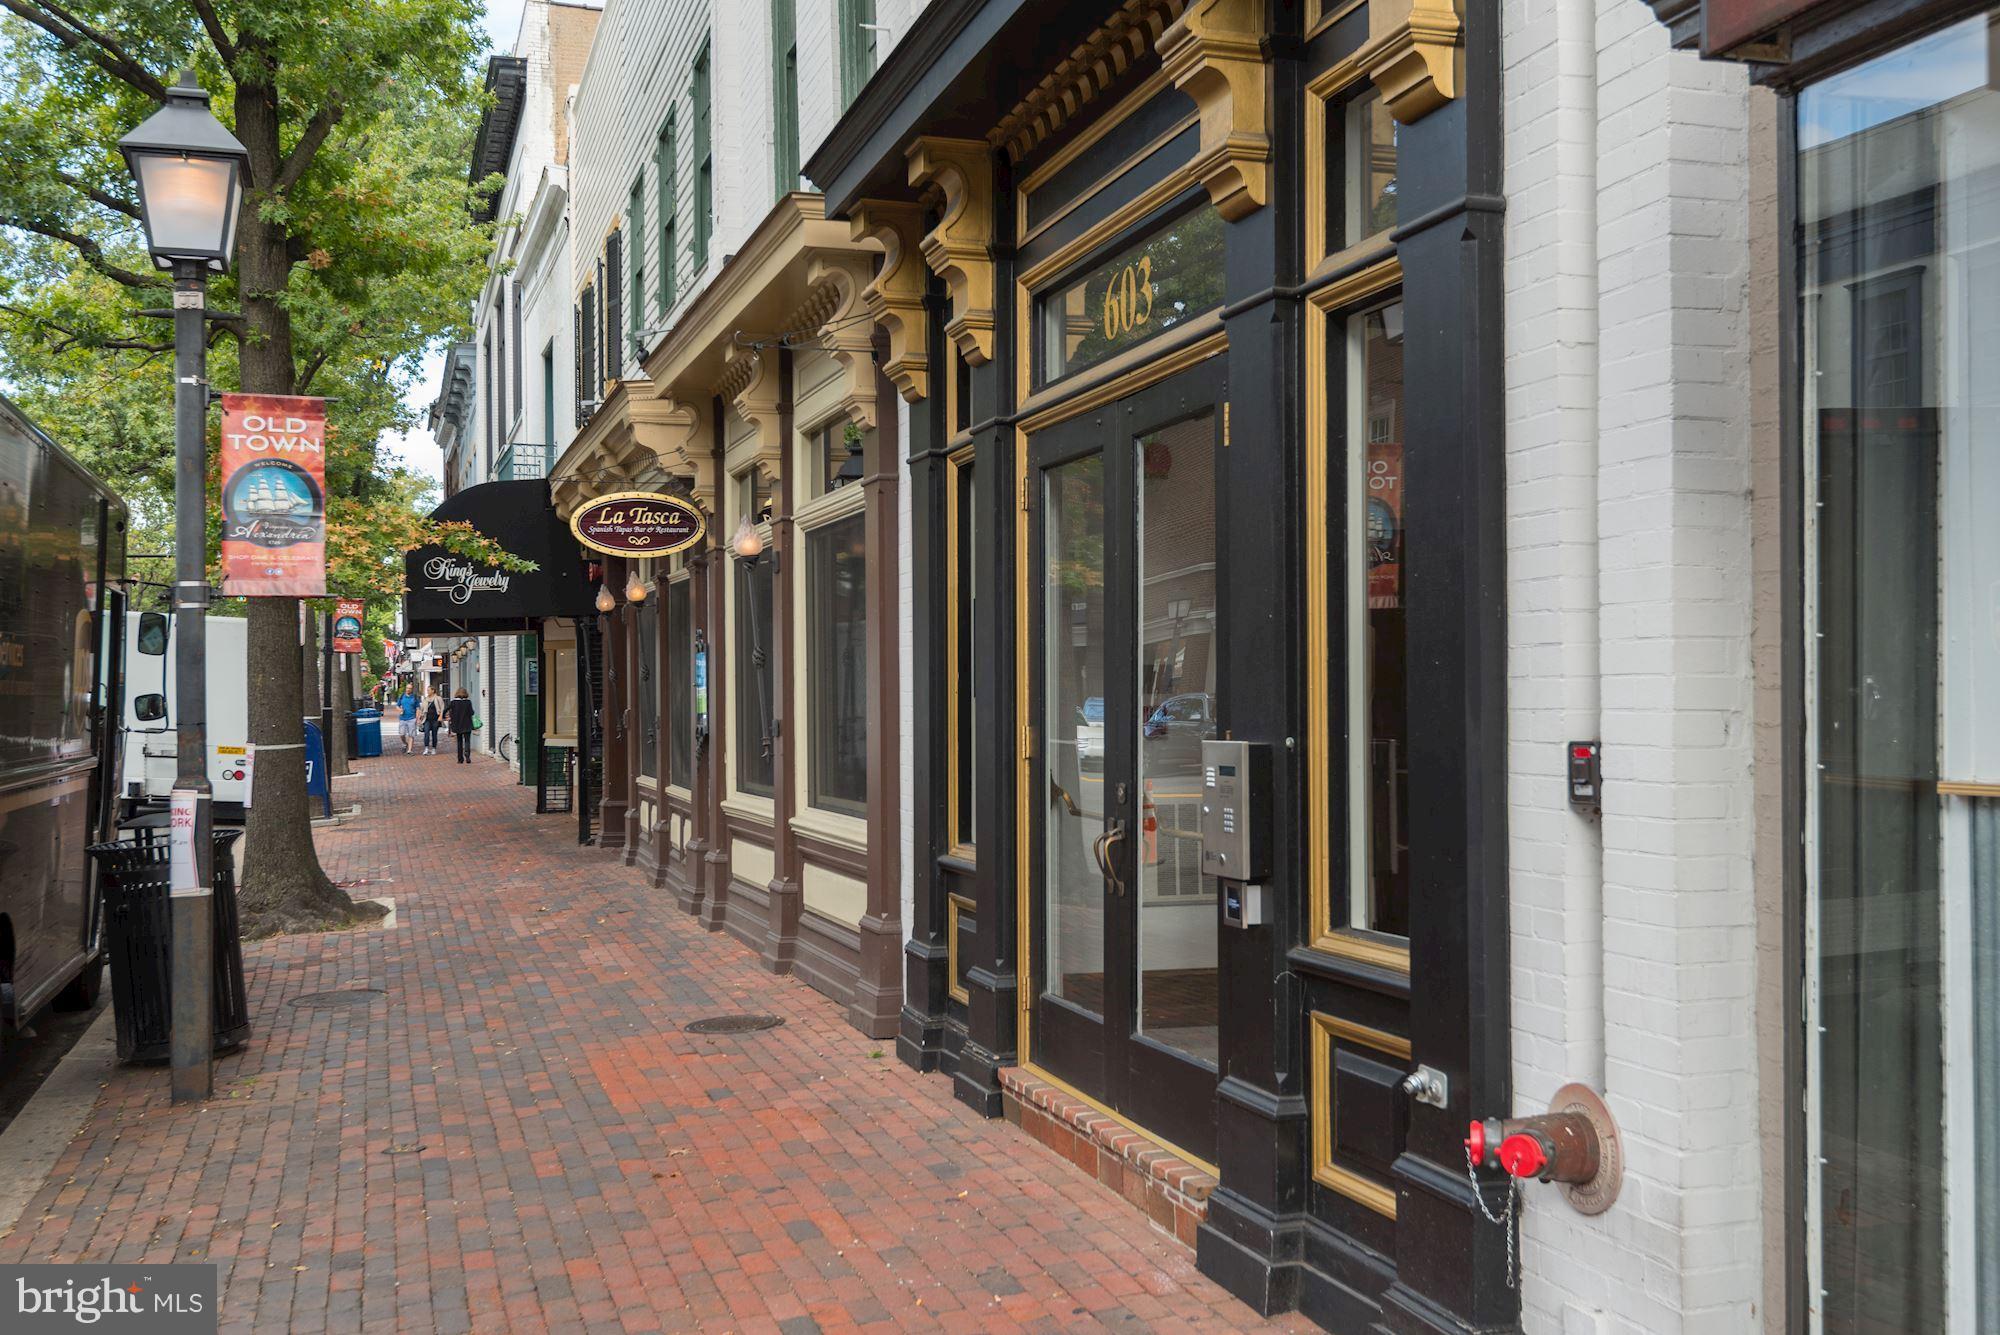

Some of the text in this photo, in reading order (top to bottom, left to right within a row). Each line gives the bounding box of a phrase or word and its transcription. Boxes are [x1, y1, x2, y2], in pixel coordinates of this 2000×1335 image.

[1104, 256, 1152, 340] 603
[242, 415, 306, 433] OLD
[226, 434, 320, 453] TOWN
[254, 461, 294, 470] WELCOME
[597, 506, 681, 525] La Tasca
[230, 520, 316, 539] Alexandria
[588, 526, 613, 535] Spanish
[614, 526, 632, 535] Tapas
[655, 526, 689, 534] Restaurant
[424, 556, 474, 583] King's
[449, 570, 510, 604] Jewelry
